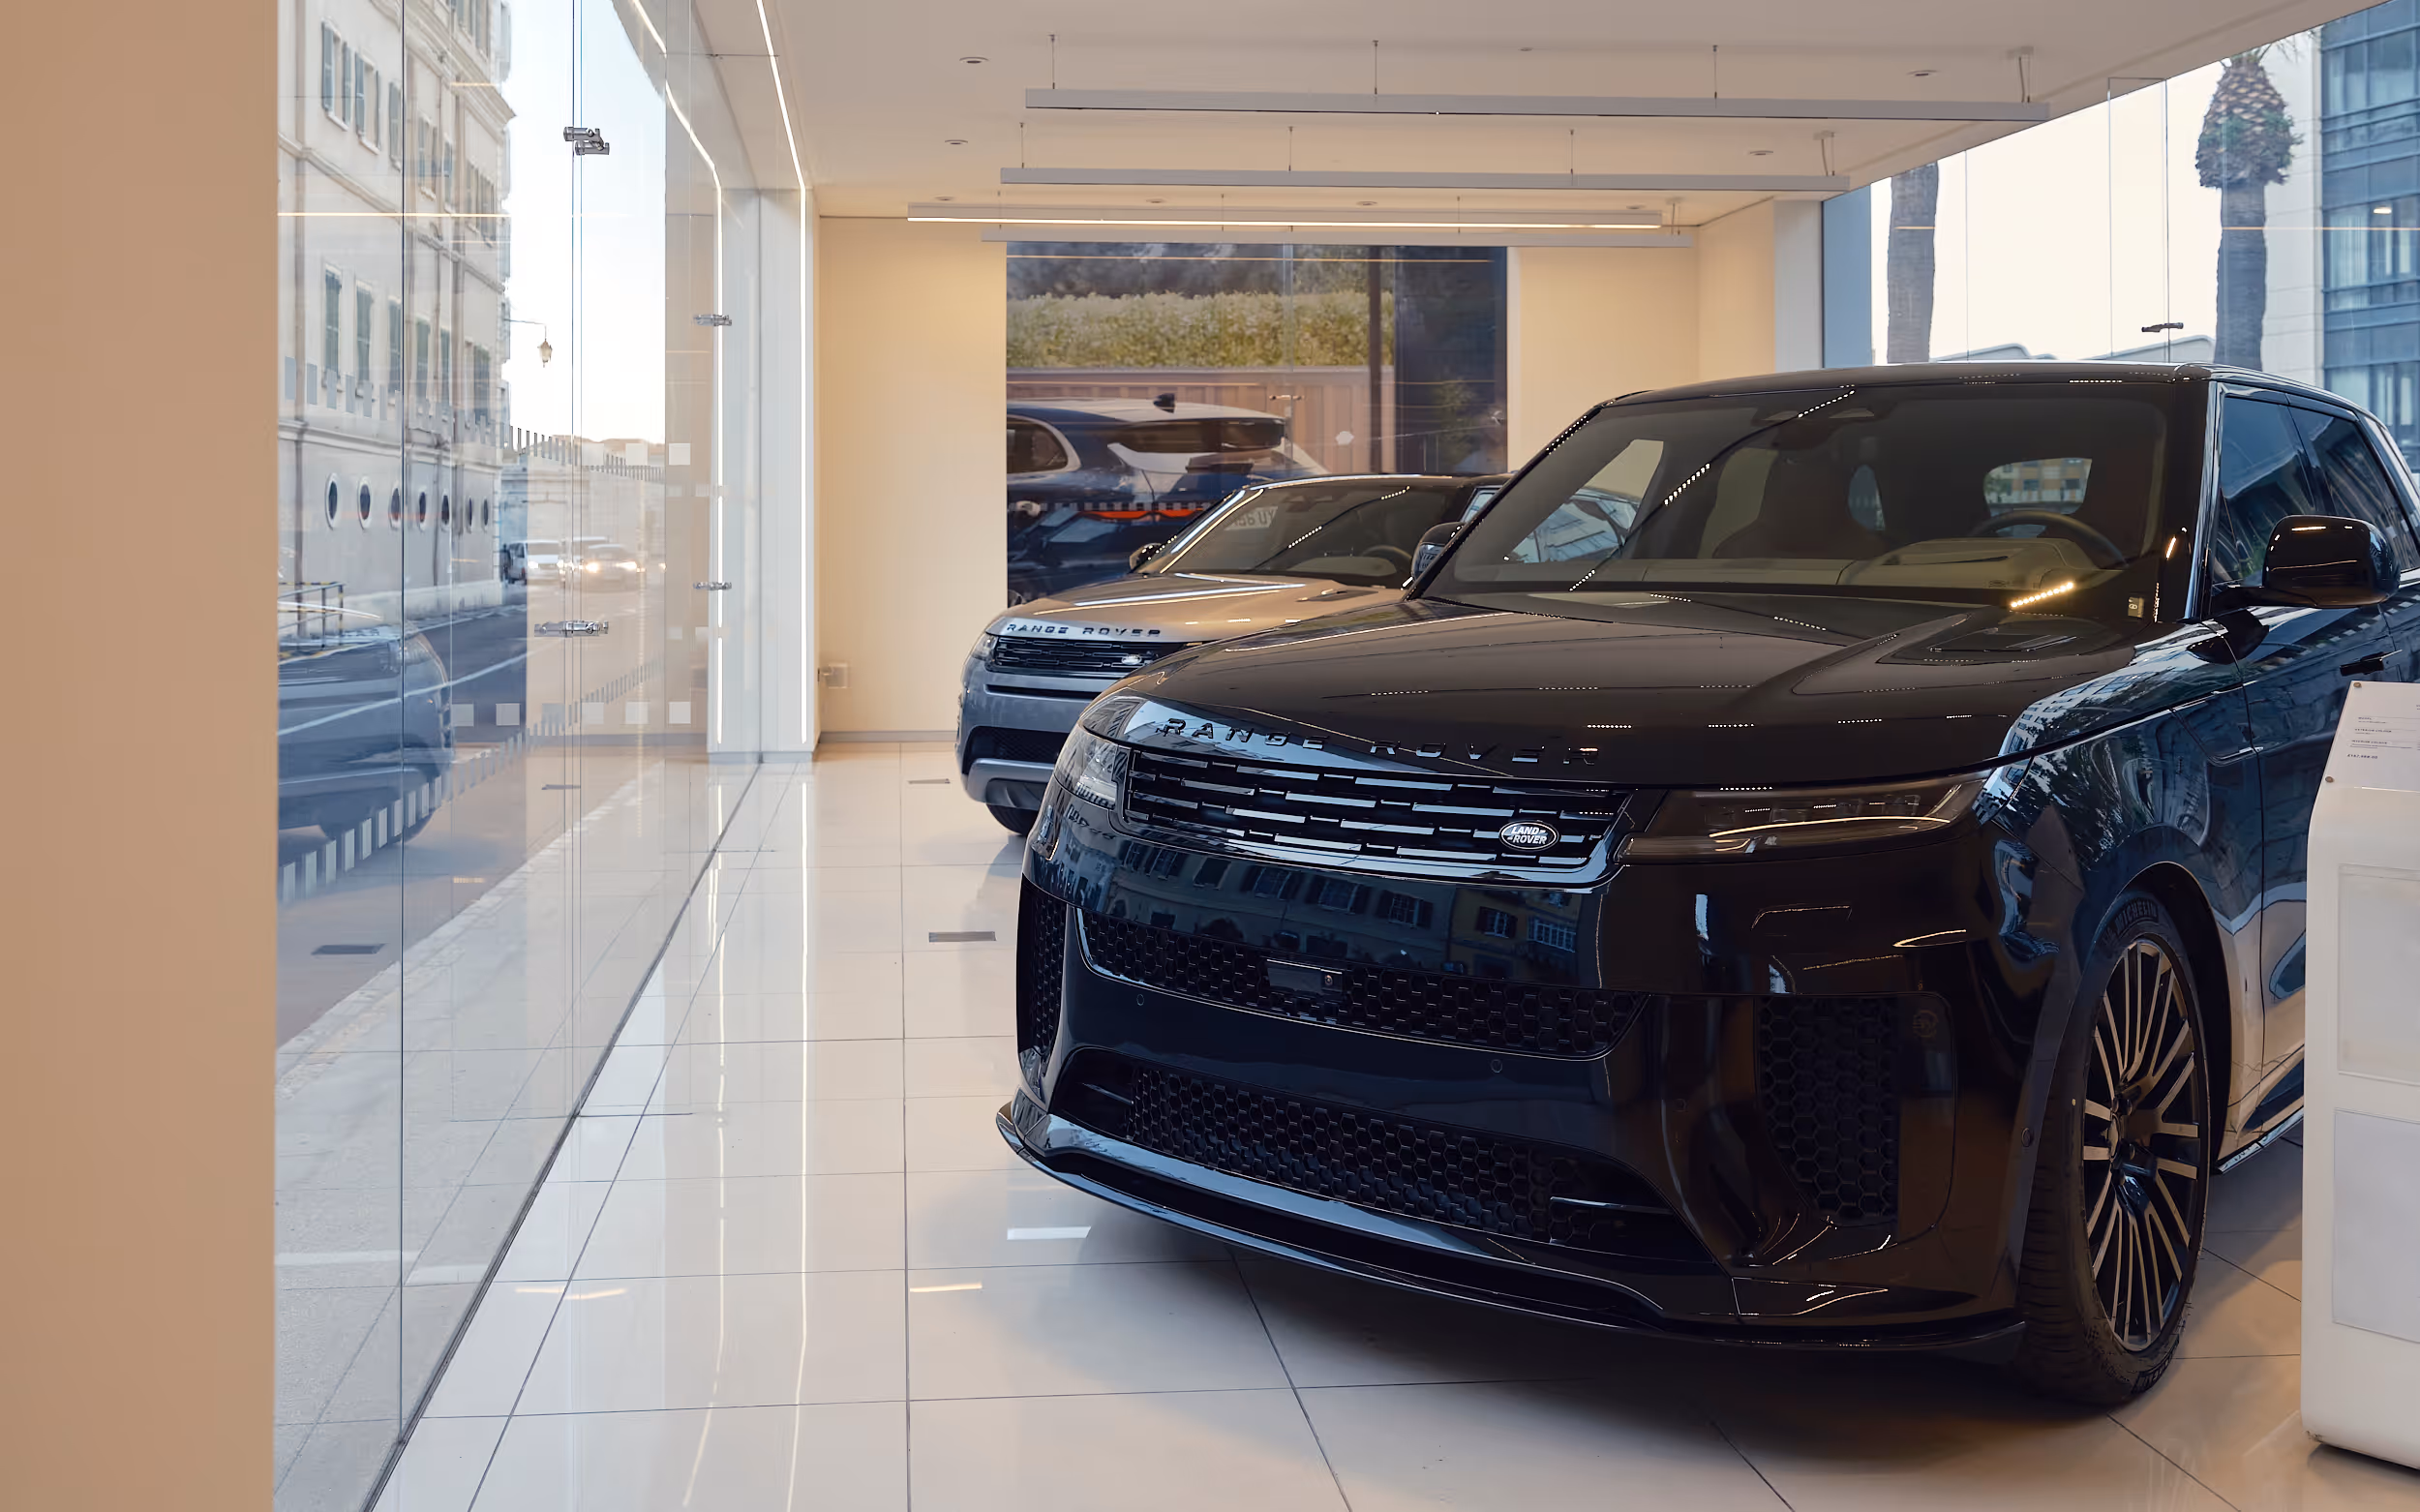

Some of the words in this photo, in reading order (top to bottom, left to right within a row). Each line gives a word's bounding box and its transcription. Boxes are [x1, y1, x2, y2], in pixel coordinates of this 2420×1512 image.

[1007, 623, 1070, 634] RANGE
[1082, 627, 1161, 637] ROVER
[1157, 717, 1330, 749] RANGE
[1370, 741, 1598, 765] ROVER
[1511, 826, 1540, 834] LAND
[1512, 834, 1547, 844] ROVER
[2114, 900, 2158, 935] MICHELIN
